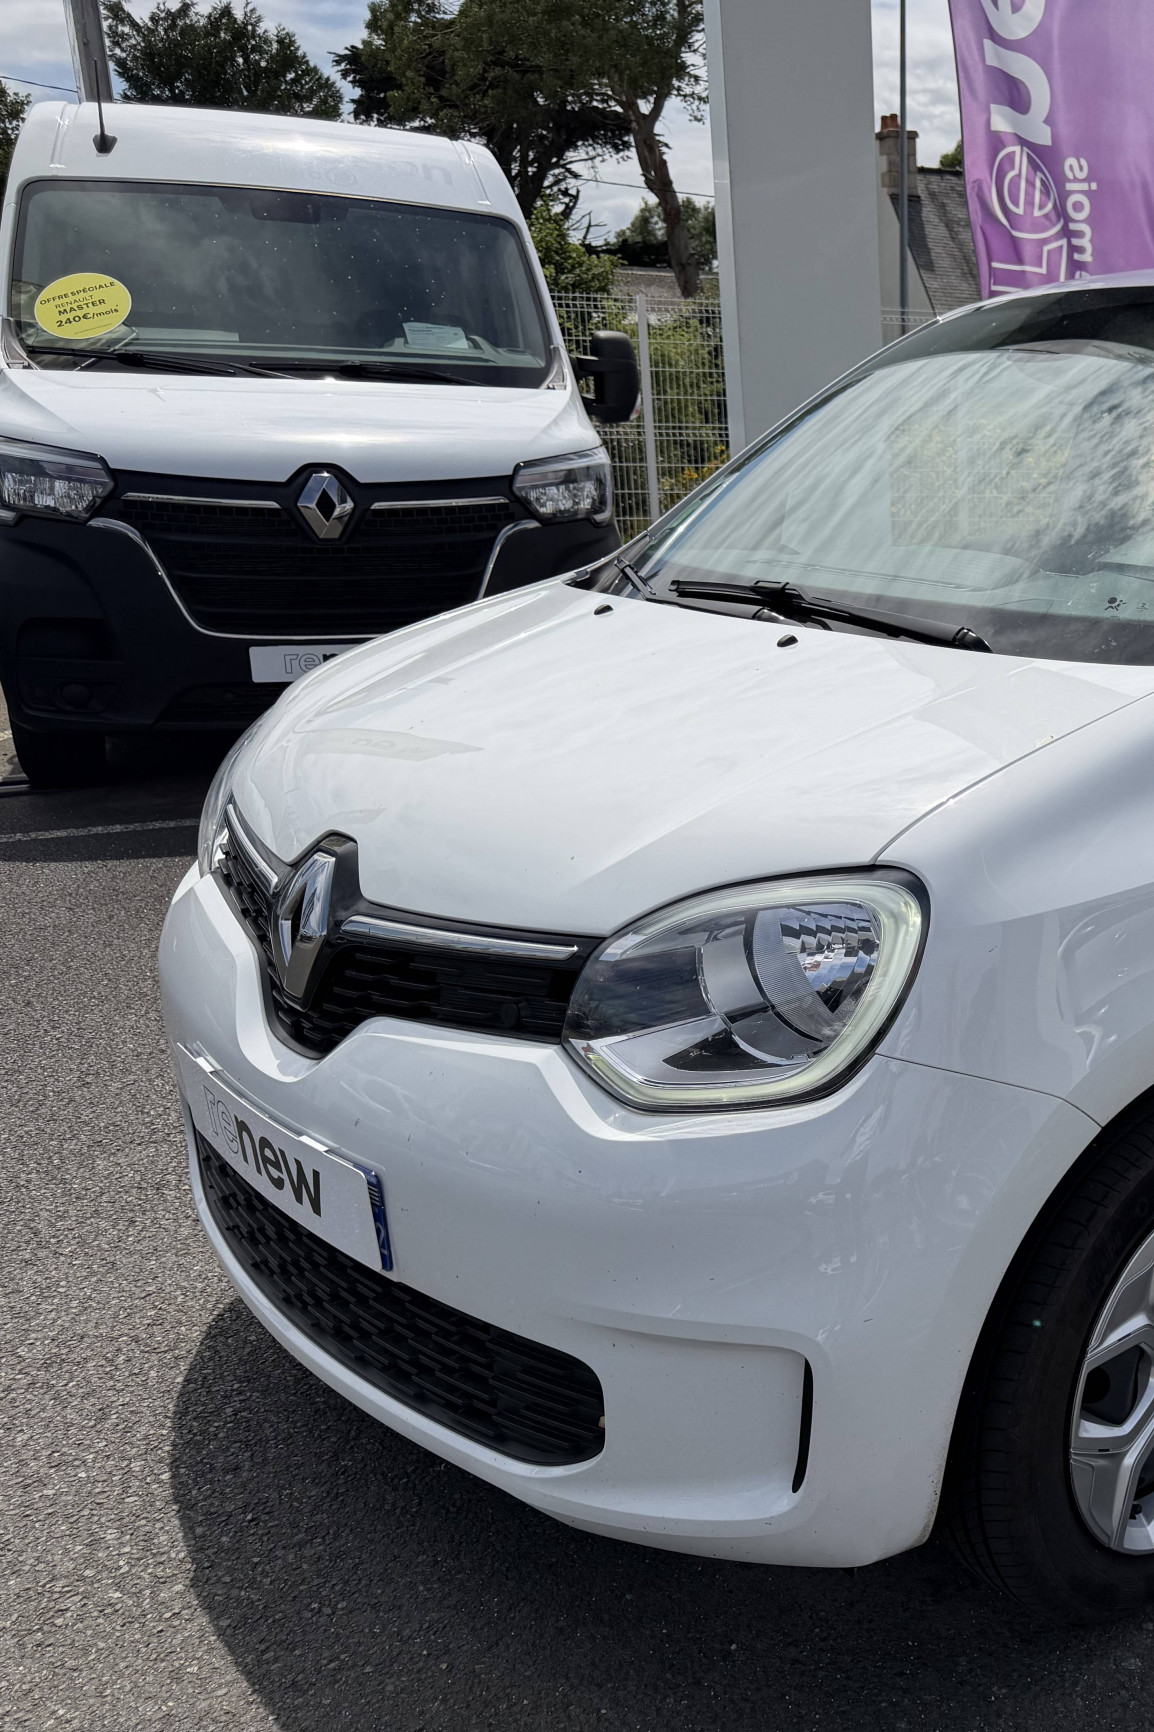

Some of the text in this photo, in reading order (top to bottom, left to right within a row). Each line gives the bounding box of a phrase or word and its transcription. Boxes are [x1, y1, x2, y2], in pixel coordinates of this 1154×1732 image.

[39, 281, 116, 306] OFFRE SPÉCIALE
[54, 294, 94, 309] RENAULT
[58, 298, 107, 317] MASTER
[203, 1084, 322, 1218] renew
